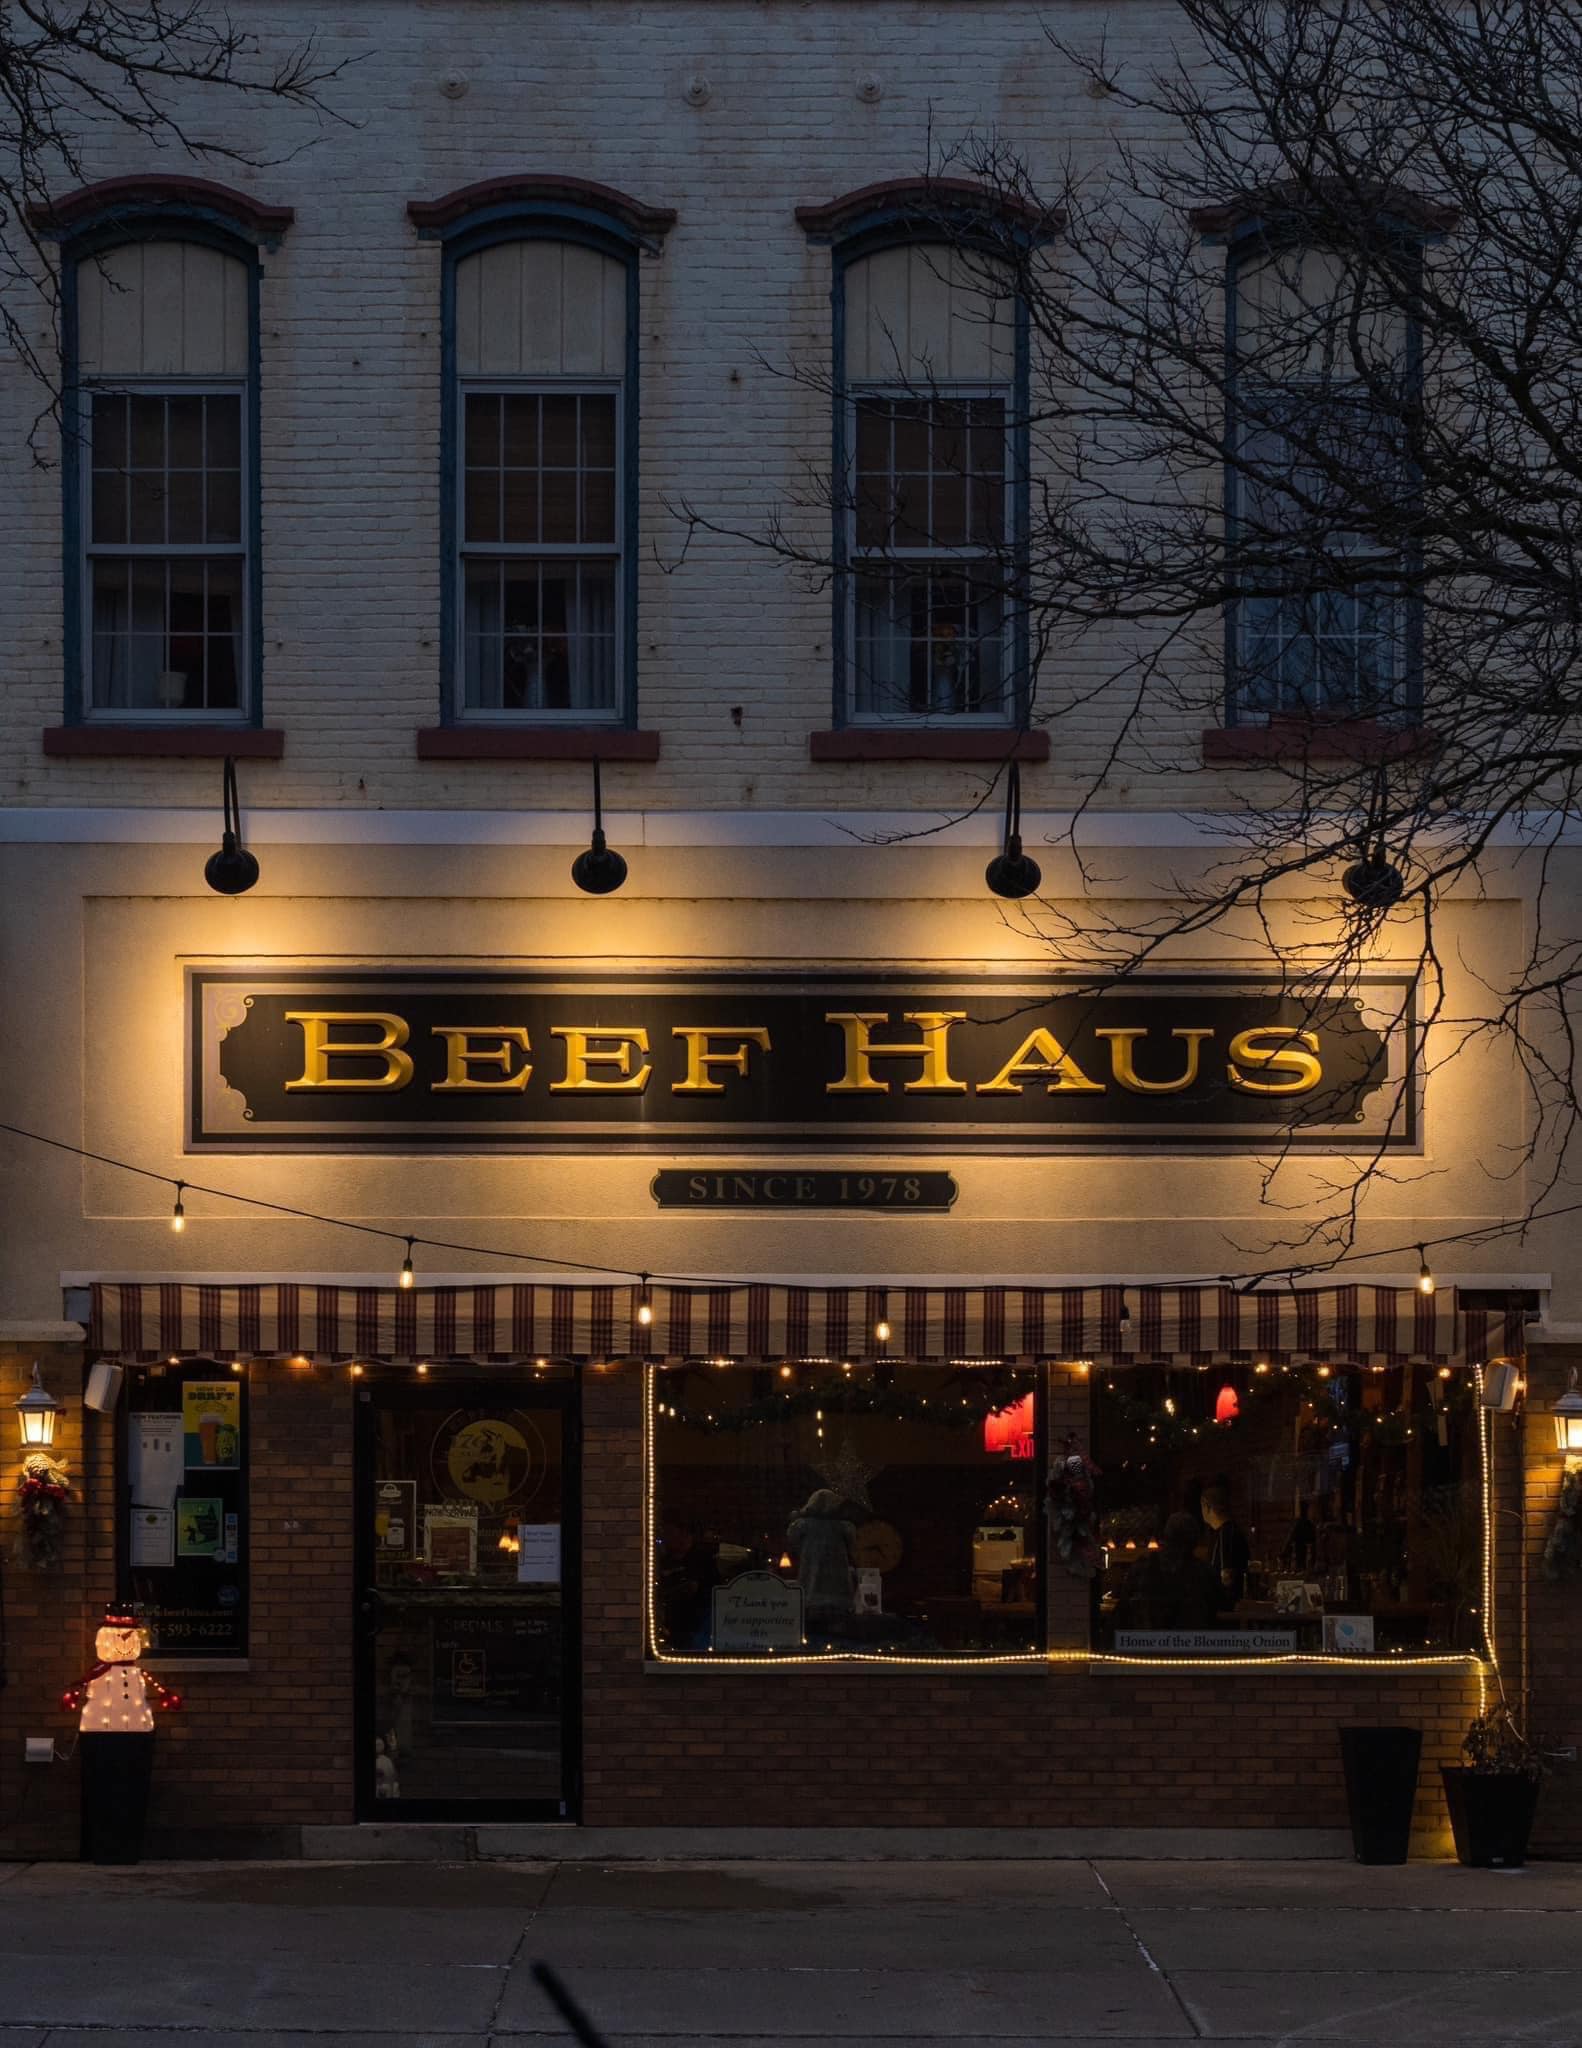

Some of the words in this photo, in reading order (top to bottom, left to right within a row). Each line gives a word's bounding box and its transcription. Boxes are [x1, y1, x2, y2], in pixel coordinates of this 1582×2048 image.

[285, 1011, 774, 1096] BEEF
[824, 1010, 1324, 1097] HAUS
[688, 1176, 817, 1201] SINCE
[839, 1177, 921, 1201] 1978
[728, 1595, 768, 1608] Thank
[770, 1599, 788, 1611] you
[741, 1614, 795, 1627] supporting
[1120, 1635, 1154, 1649] Home
[1158, 1634, 1172, 1649] of
[1172, 1635, 1191, 1649] the
[1194, 1635, 1250, 1651] Blooming
[1252, 1635, 1290, 1649] Onion
